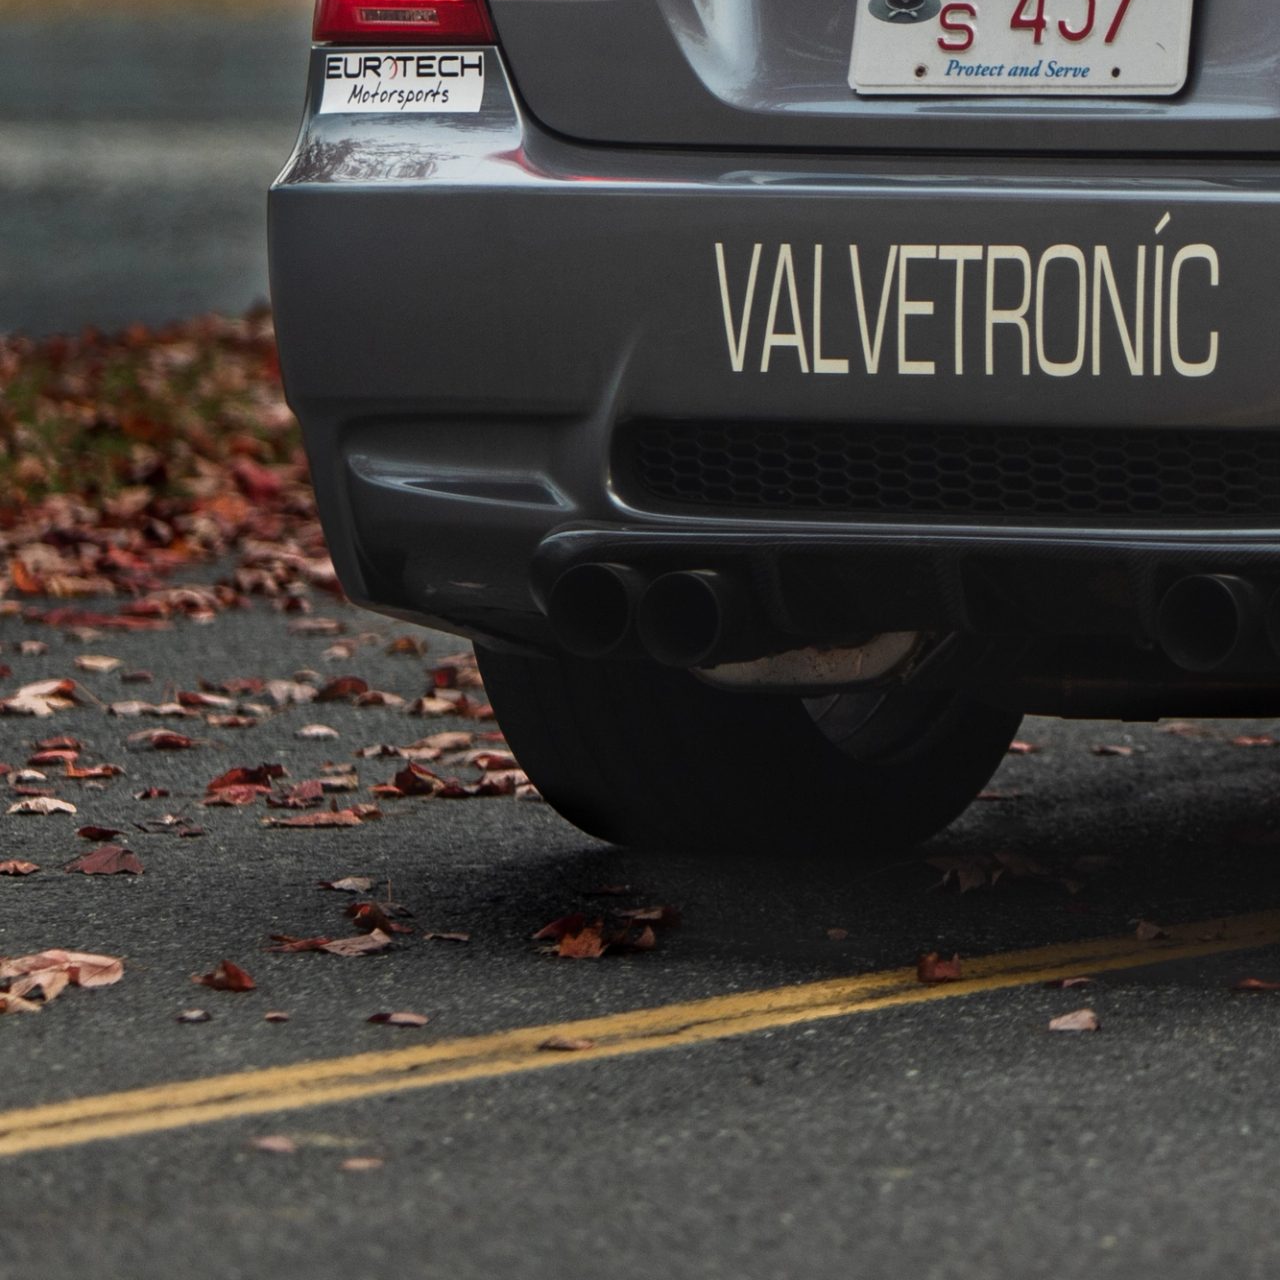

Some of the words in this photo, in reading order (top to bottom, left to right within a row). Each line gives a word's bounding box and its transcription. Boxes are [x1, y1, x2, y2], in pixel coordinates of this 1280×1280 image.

[944, 59, 1005, 78] Protect
[1008, 60, 1037, 78] and
[1039, 61, 1091, 78] Serve
[347, 80, 450, 111] Motorsports
